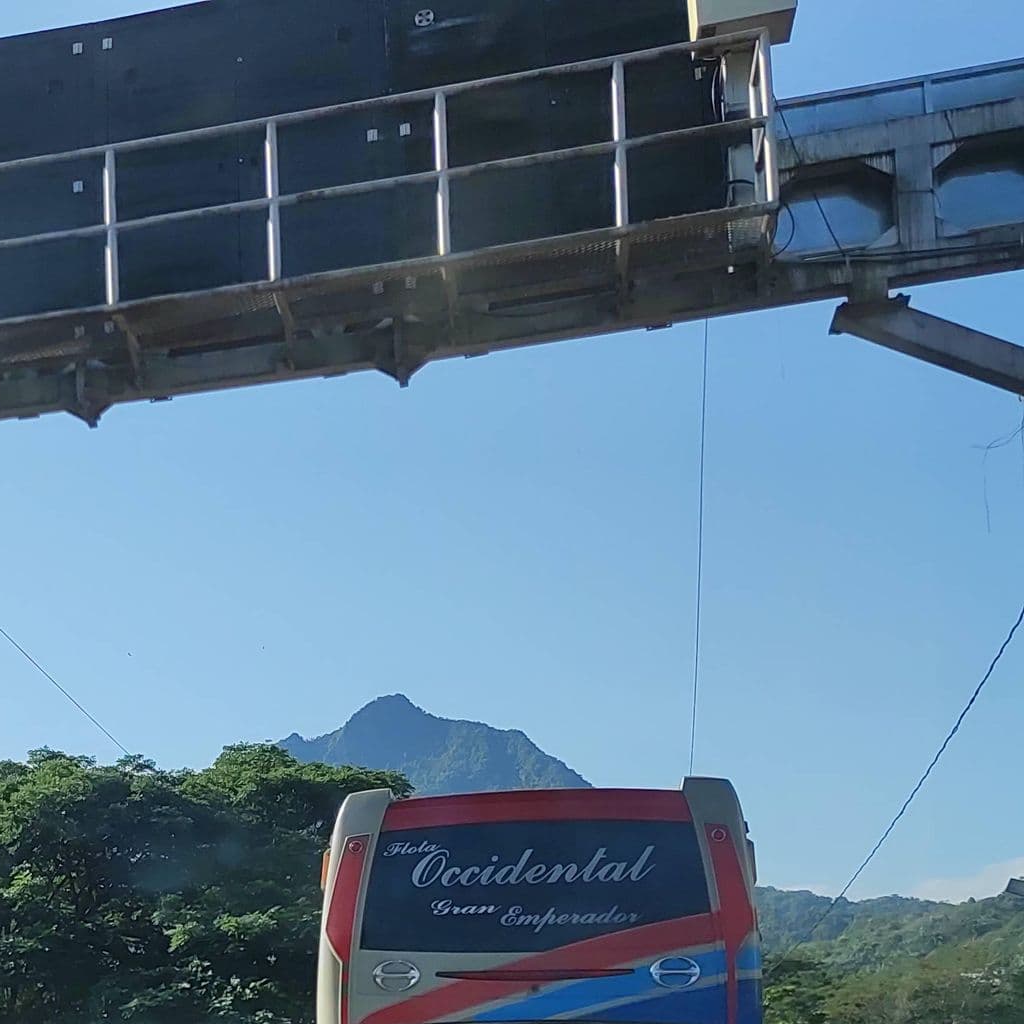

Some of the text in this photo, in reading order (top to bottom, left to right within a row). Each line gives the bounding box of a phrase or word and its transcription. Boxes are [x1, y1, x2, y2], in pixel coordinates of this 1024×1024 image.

[383, 841, 440, 856] Flota
[411, 845, 656, 888] Occidental
[431, 899, 642, 933] Gran Emperador
